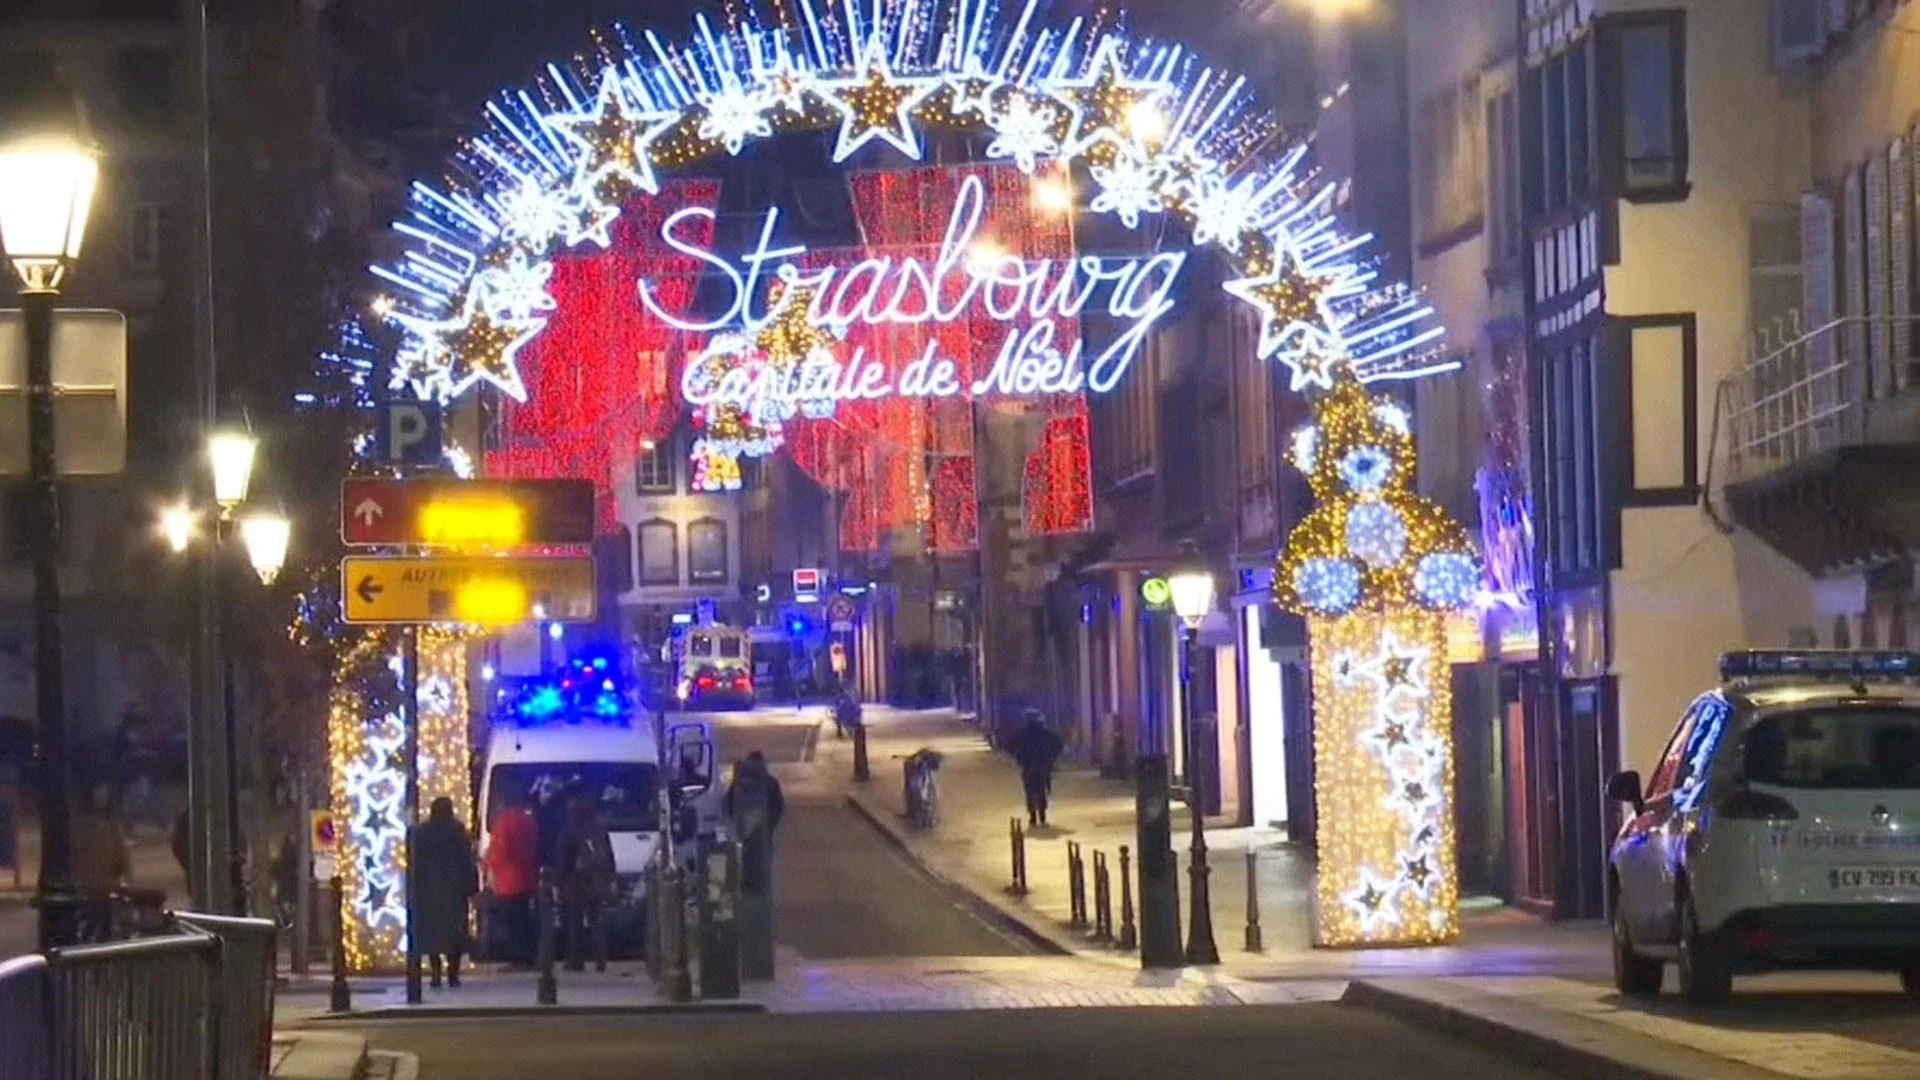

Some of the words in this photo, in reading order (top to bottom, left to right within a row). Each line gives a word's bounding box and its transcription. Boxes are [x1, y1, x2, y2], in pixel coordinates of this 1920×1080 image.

[637, 175, 1187, 393] Strasbourg
[682, 344, 893, 412] Capitale
[899, 337, 960, 396] de
[970, 319, 1085, 395] Noël
[389, 405, 428, 459] P
[402, 567, 471, 583] AUTR
